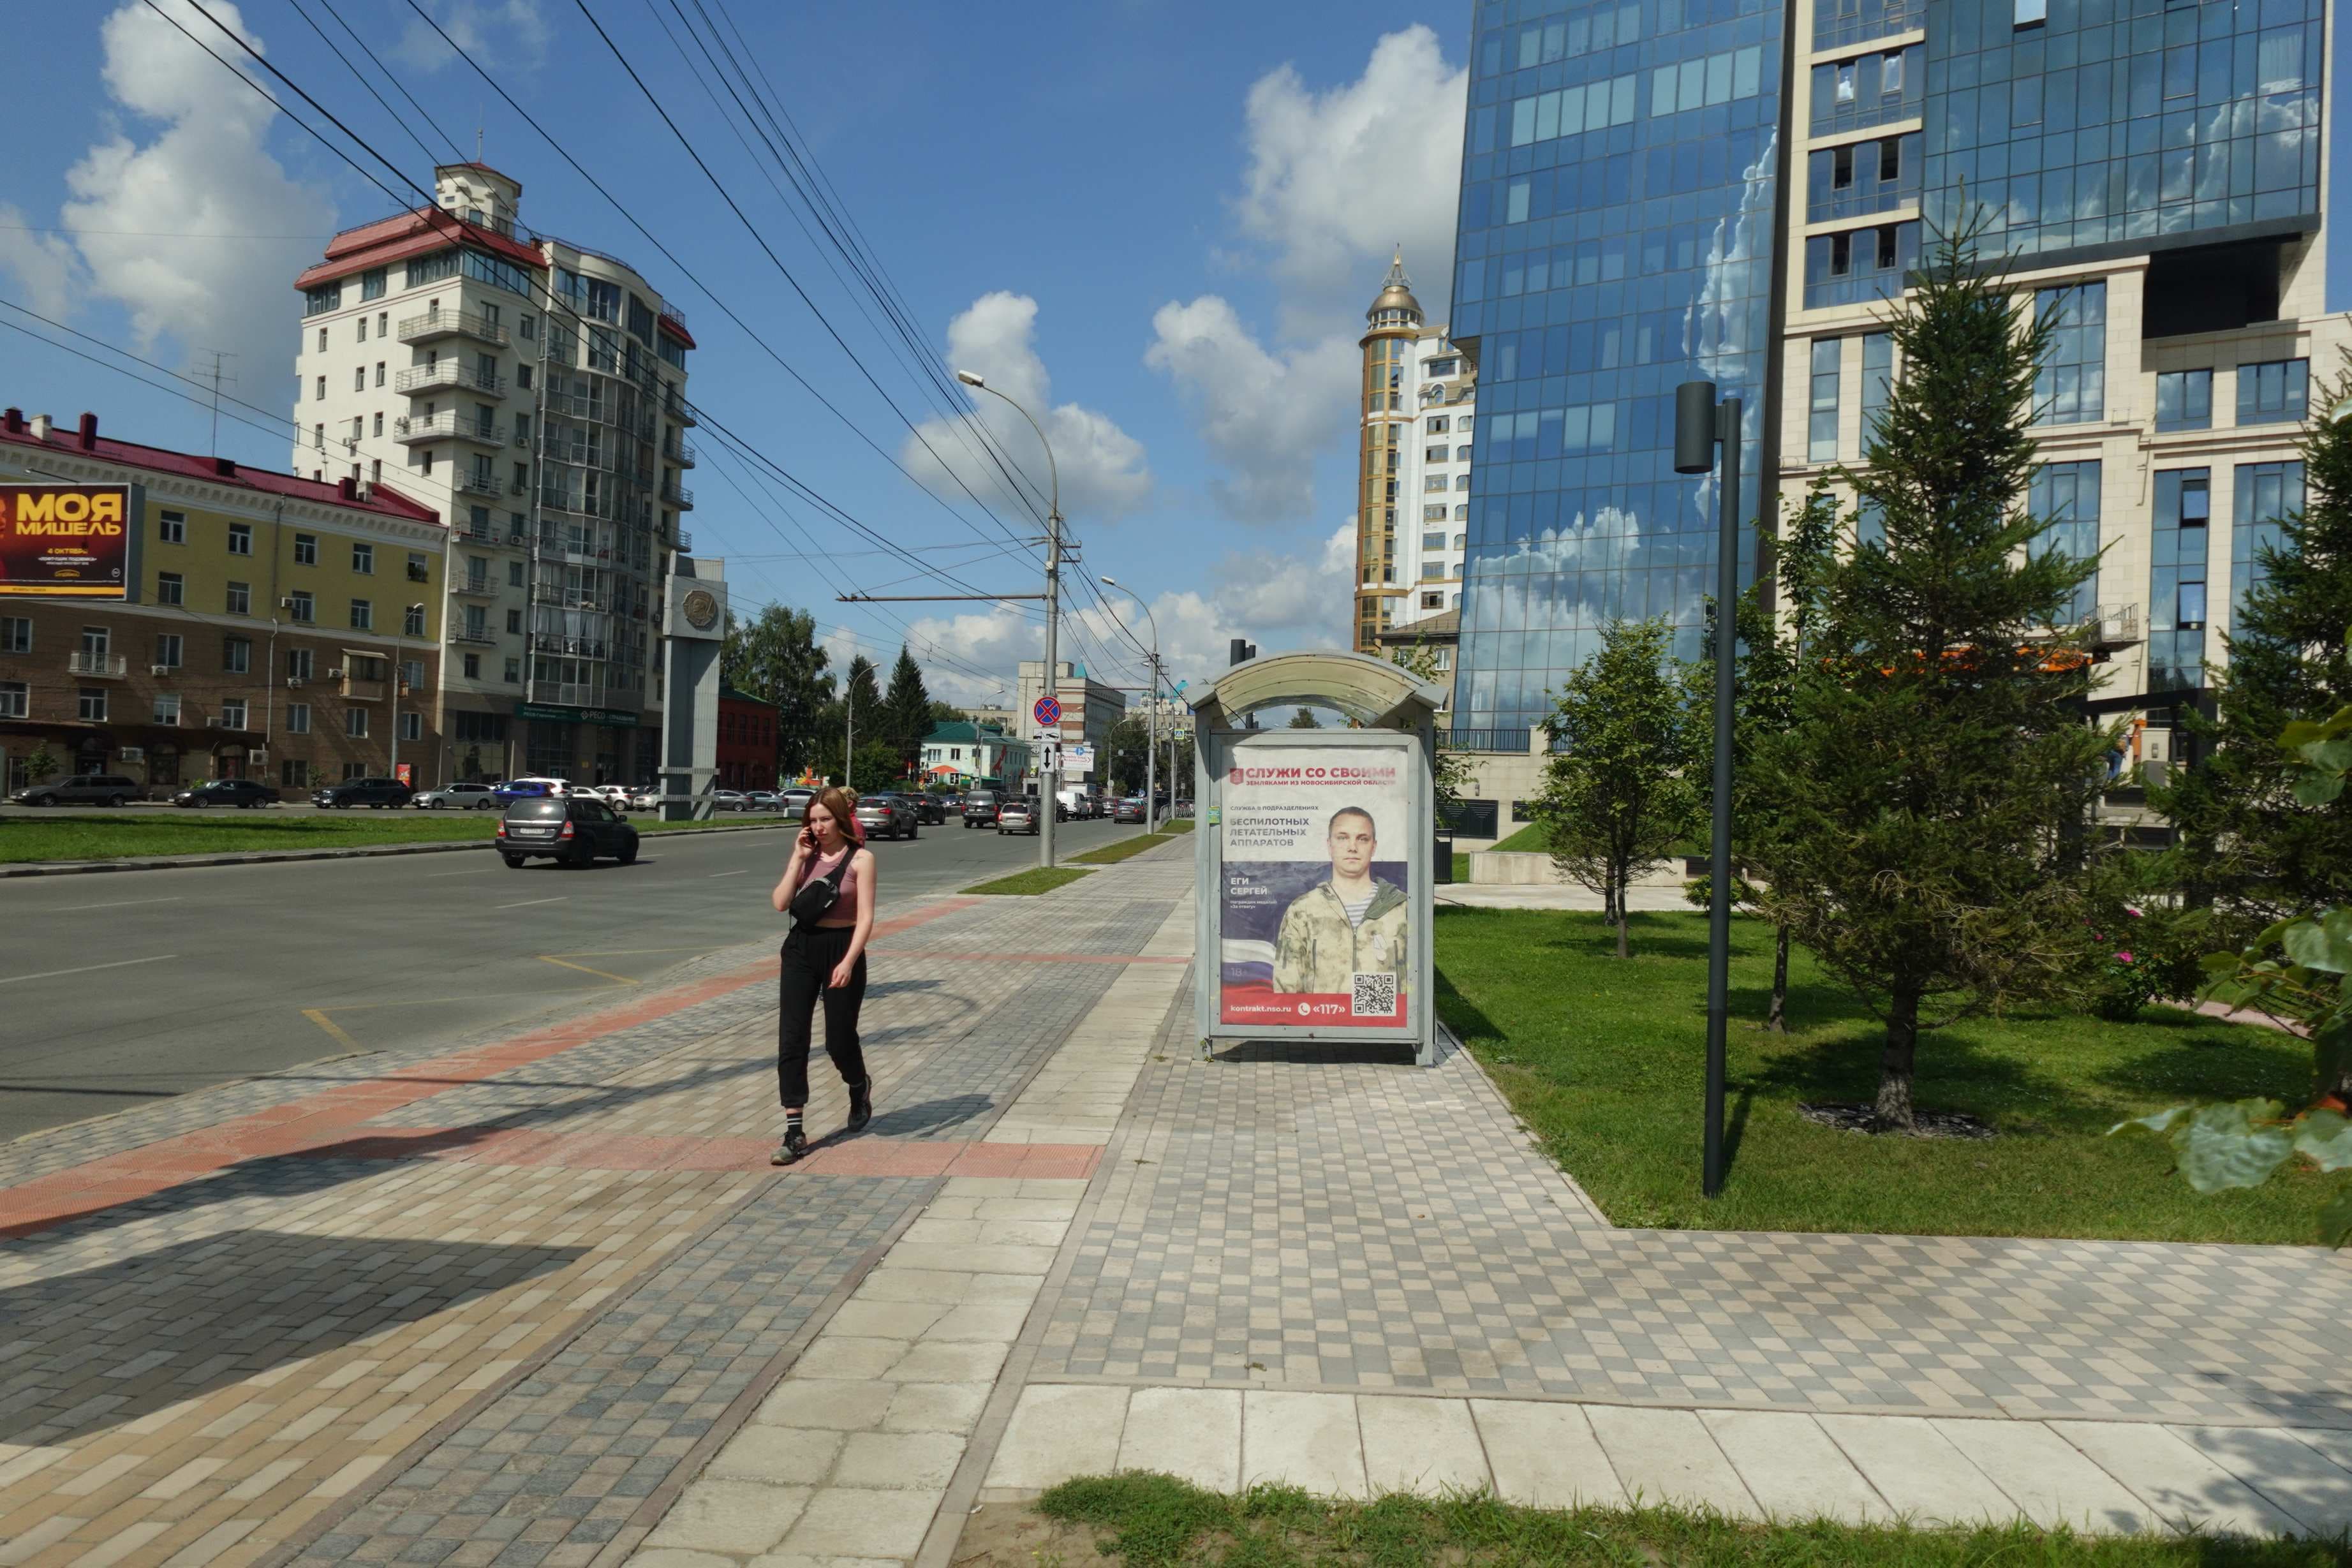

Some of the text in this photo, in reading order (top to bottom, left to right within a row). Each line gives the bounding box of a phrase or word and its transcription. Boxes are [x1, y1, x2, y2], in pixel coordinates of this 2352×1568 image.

[17, 493, 122, 522] МОЯ
[16, 522, 121, 536] МИШЕЛЬ
[589, 711, 605, 720] РЕСО
[1246, 767, 1395, 778] СЛУЖИ СО СВОИМИ
[1230, 818, 1310, 826] БЕСПИЛОТНЫХ
[1230, 839, 1294, 847] АППАРАТОВ
[1231, 885, 1268, 895] СЕРГЕЙ
[1313, 1004, 1345, 1014] «117»
